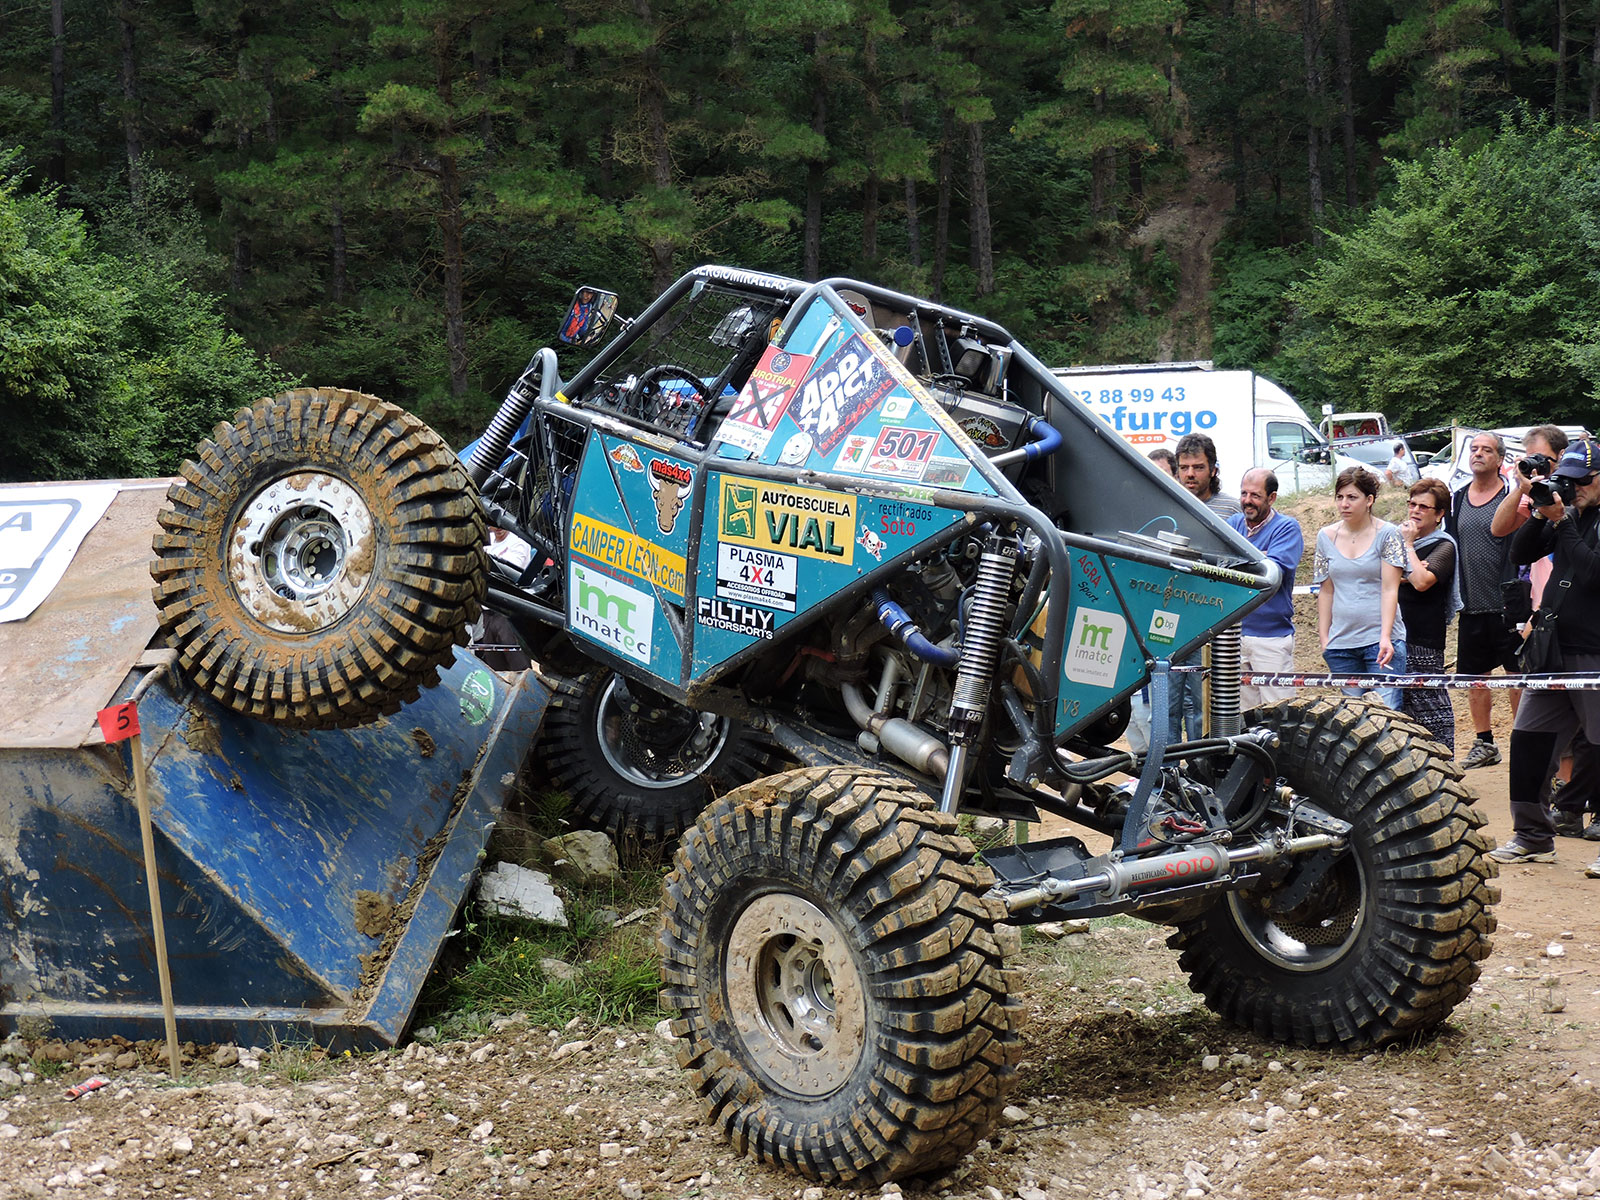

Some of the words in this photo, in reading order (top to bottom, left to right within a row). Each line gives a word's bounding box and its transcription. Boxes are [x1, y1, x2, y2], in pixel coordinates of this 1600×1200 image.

[1073, 390, 1093, 404] 2
[1099, 389, 1123, 404] 88
[1130, 388, 1154, 403] 99
[1161, 387, 1186, 401] 43
[878, 431, 934, 460] 501
[761, 490, 851, 517] AUTOESCUELA
[878, 502, 933, 521] rectificados
[764, 510, 845, 556] VIAL
[880, 515, 916, 537] Soto
[572, 521, 625, 566] CAMPER
[730, 547, 785, 571] PLASMA
[739, 565, 775, 587] 4X4
[1077, 554, 1103, 589] AGRA
[1077, 581, 1099, 602] Sport
[698, 597, 774, 630] FILTHY
[575, 606, 647, 655] imatec
[698, 615, 774, 640] MOTORSPORTS
[1074, 646, 1113, 665] imatec
[117, 707, 130, 731] 5
[1062, 698, 1081, 718] V8
[1165, 855, 1215, 878] SOTO
